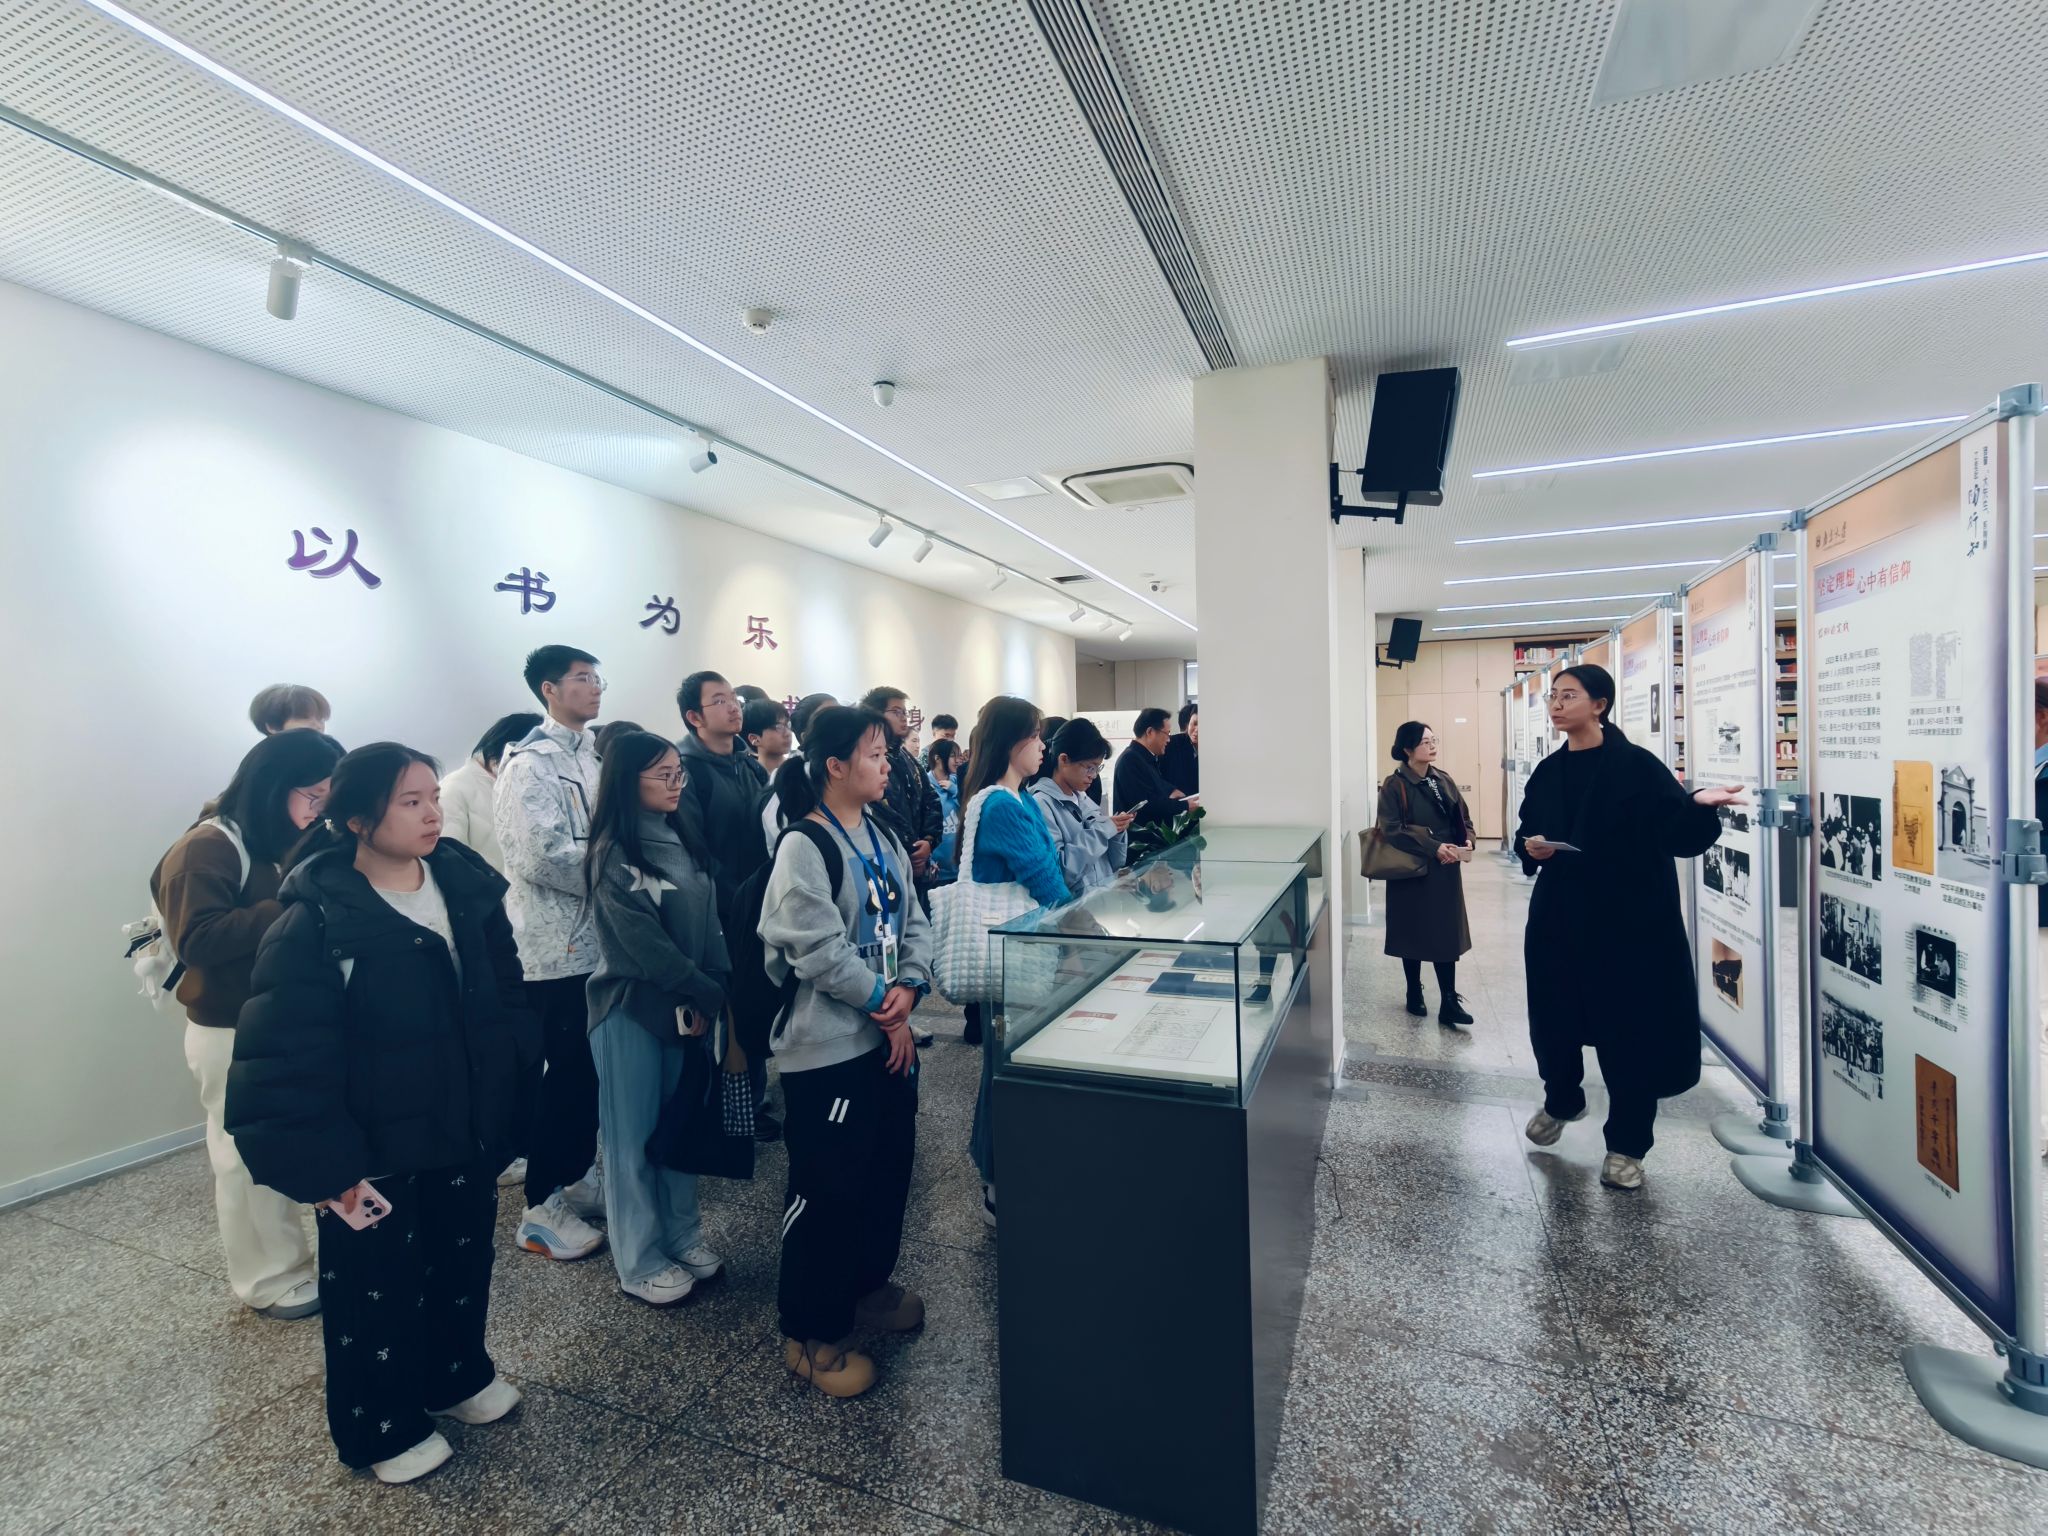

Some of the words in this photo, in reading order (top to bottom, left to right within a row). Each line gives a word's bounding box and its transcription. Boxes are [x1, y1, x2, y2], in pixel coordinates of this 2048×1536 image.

[1857, 560, 1911, 593] 心中有信仰
